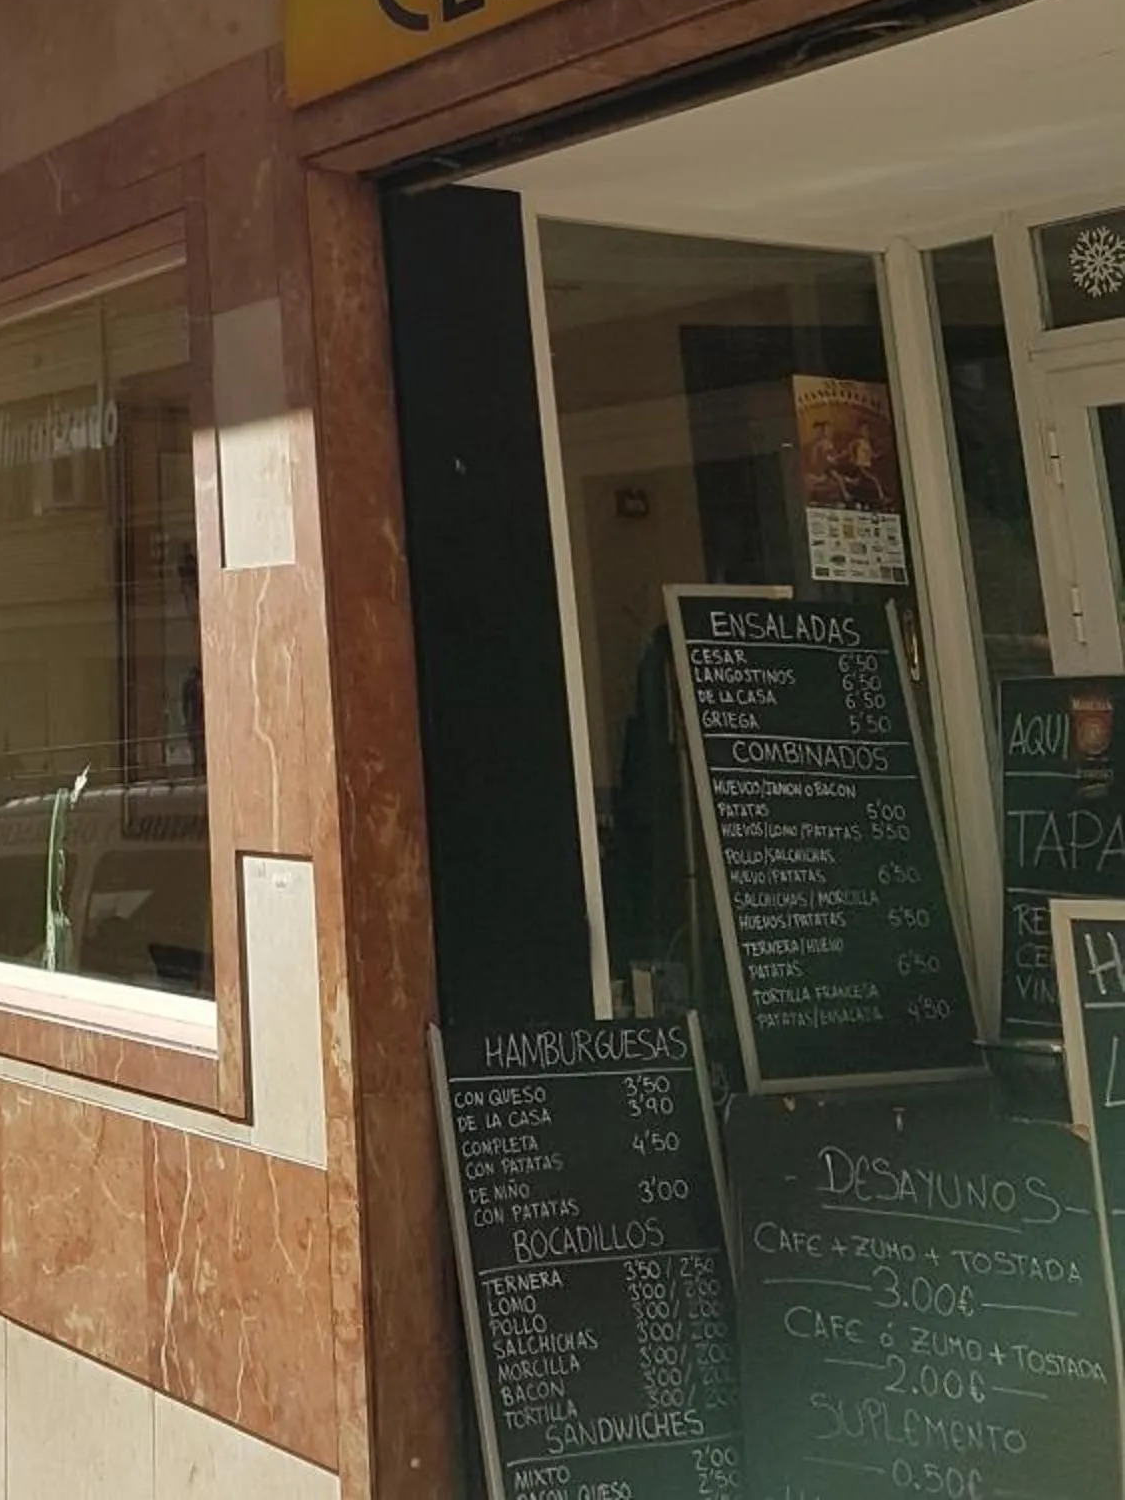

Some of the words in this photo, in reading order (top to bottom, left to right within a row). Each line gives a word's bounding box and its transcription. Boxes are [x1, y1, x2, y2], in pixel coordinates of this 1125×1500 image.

[710, 611, 860, 646] ENSALADAS
[691, 649, 748, 666] CESAR
[695, 666, 797, 686] LANGOSTINOS
[698, 689, 716, 704] DE
[719, 690, 734, 703] LA
[736, 689, 778, 707] CASA
[702, 708, 761, 731] GRIEGA
[1009, 712, 1069, 761] AQUI
[732, 740, 888, 771] COMBINADOS
[718, 802, 770, 819] PATATAS
[748, 961, 804, 980] PATATAS
[484, 1025, 687, 1068] HAMBURGUESAS
[454, 1091, 484, 1109] CON
[488, 1085, 546, 1107] QUESO
[623, 1074, 670, 1098] 3'50
[458, 1114, 478, 1132] DE
[486, 1112, 502, 1129] LA
[508, 1107, 552, 1129] CASA
[462, 1134, 539, 1158] COMPLETA
[465, 1162, 495, 1181] CON
[501, 1153, 564, 1175] PATATAS
[469, 1187, 490, 1206] DE
[493, 1178, 531, 1202] NIÑO
[816, 1145, 1062, 1225] DESAYUNOS
[473, 1206, 505, 1228] CON
[511, 1197, 581, 1222] PATATAS
[512, 1216, 664, 1263] BOCADILLOS
[754, 1220, 824, 1258] CAFE
[851, 1235, 916, 1263] ZUMO
[950, 1250, 1083, 1286] TOSTADA
[482, 1268, 564, 1297] TERNERA
[489, 1295, 536, 1318] LOMO
[490, 1313, 548, 1338] POLLO
[493, 1329, 599, 1360] SALCHICHAS
[784, 1305, 866, 1345] CAFE
[909, 1326, 982, 1363] ZUMO
[1010, 1343, 1108, 1386] TOSTADA
[498, 1354, 581, 1383] MORCILLA
[501, 1377, 565, 1408] BACON
[505, 1399, 579, 1431] TORTILLA
[809, 1392, 1028, 1456] SUPLEMENTO
[544, 1408, 705, 1455] SANDWICHES
[515, 1464, 570, 1491] MIXTO
